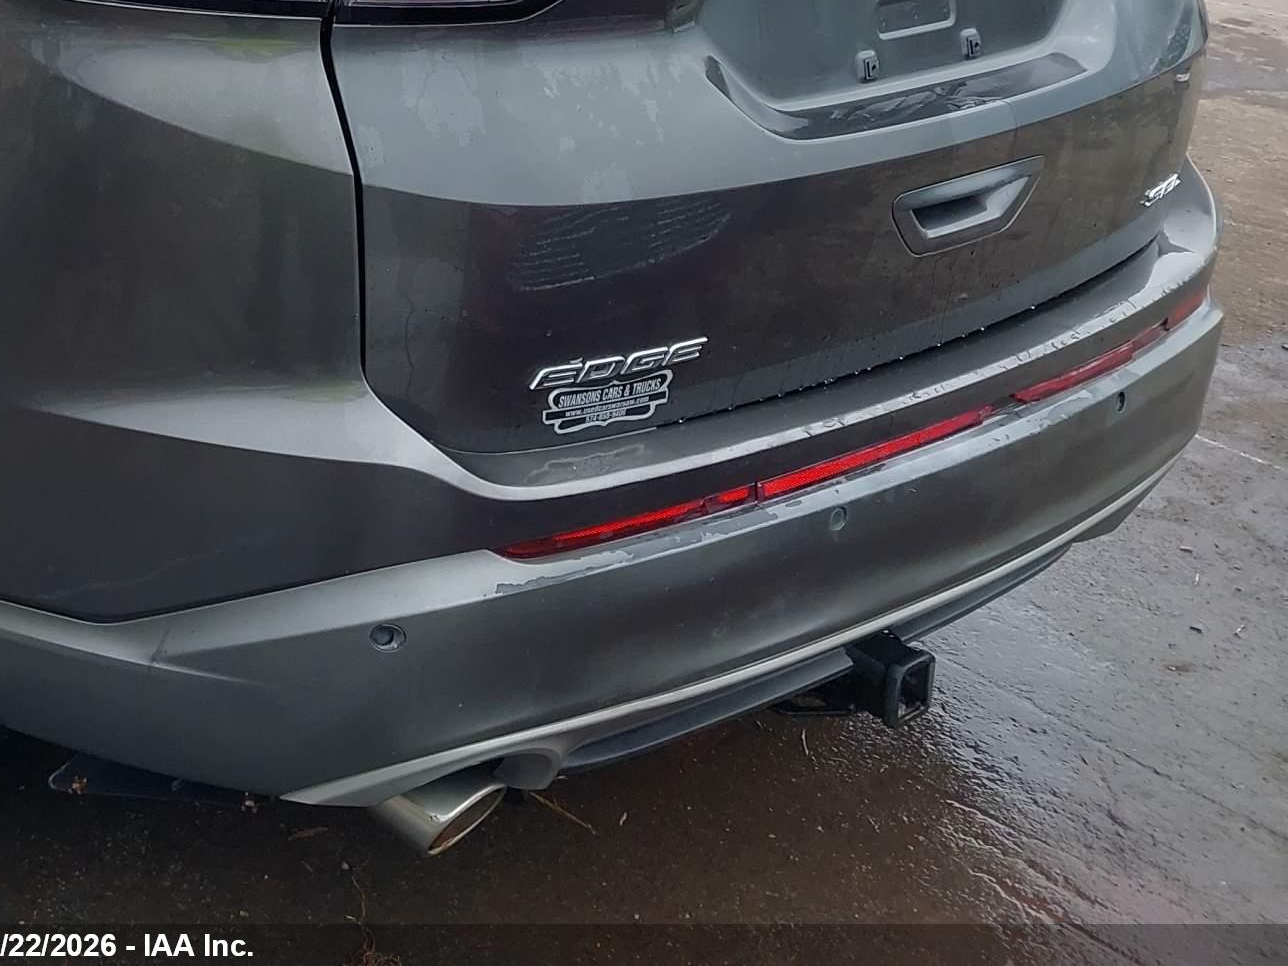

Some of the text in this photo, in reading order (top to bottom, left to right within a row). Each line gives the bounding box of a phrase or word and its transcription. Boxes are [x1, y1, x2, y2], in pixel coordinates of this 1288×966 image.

[529, 336, 708, 391] EDGE
[558, 377, 662, 408] SWANSONS CARS & TRUCKS
